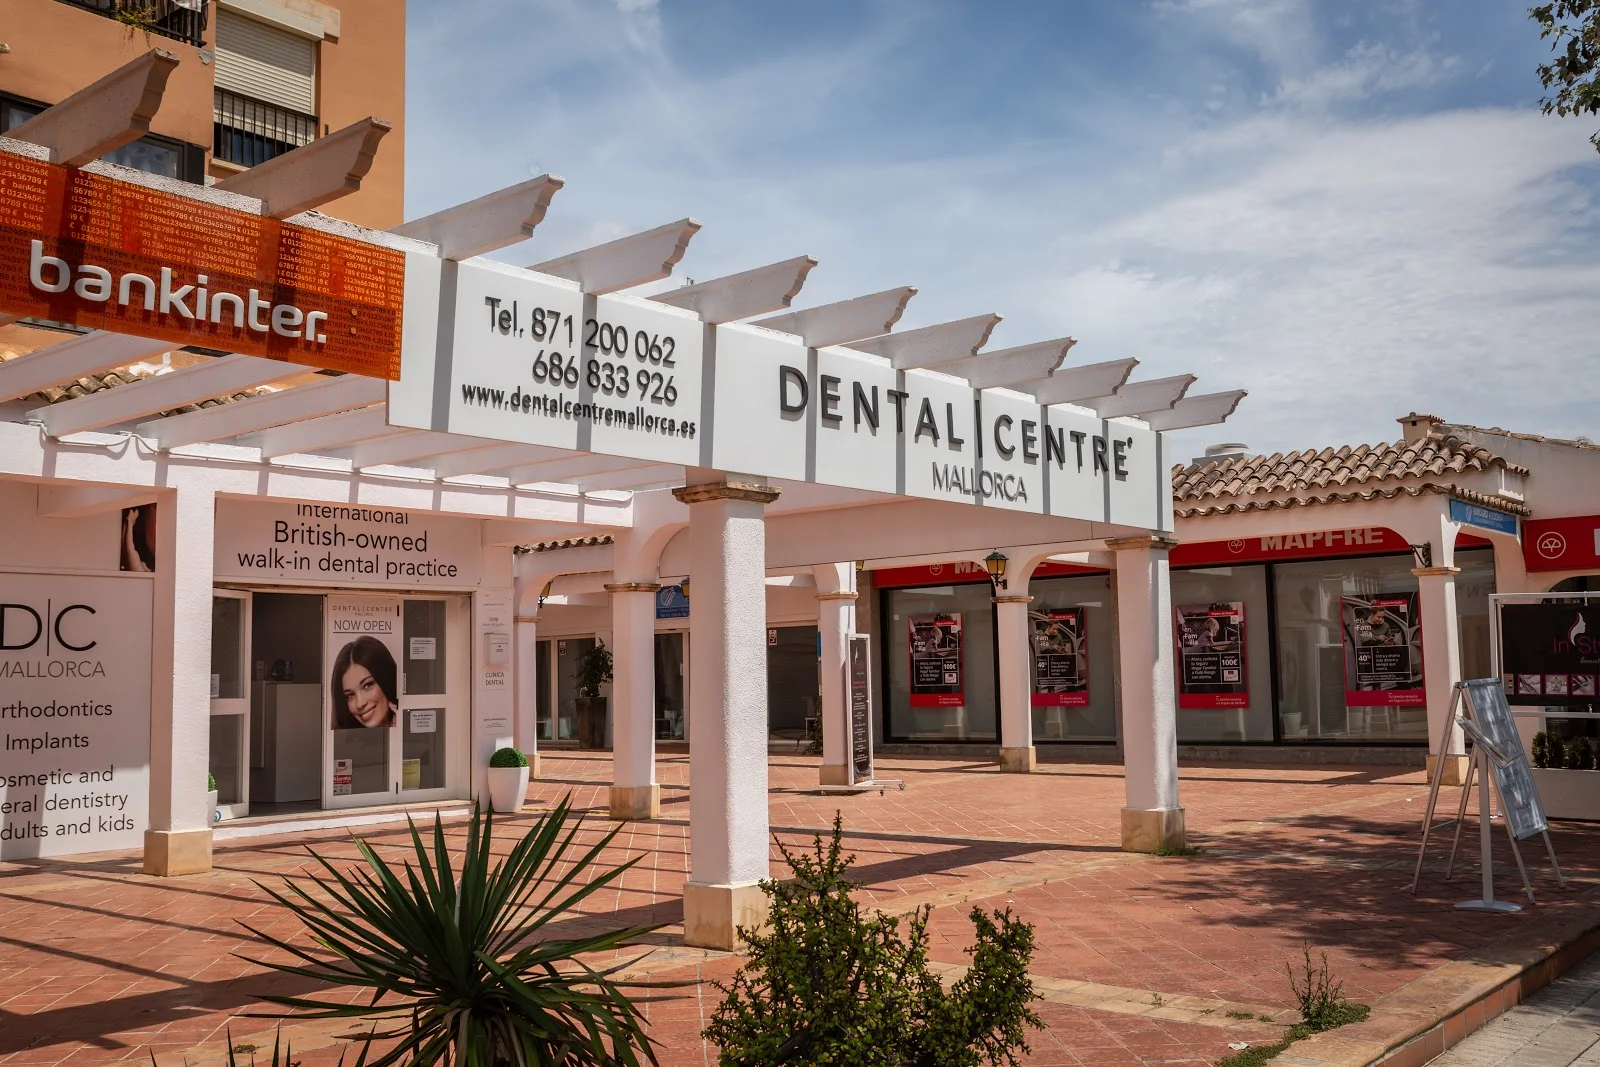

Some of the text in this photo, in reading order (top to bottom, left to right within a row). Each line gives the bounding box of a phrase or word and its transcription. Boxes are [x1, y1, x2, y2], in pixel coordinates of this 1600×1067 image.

[485, 296, 676, 365] Tel. 871 200 062
[533, 350, 678, 404] 686 833 926
[462, 384, 696, 435] www.dentalcentremallorca.es
[932, 462, 1028, 502] MALLORCA
[274, 521, 427, 553] British-owned
[1260, 527, 1384, 552] MAPFRE
[238, 548, 458, 580] walk-in dental practice
[334, 620, 392, 632] NOW OPEN
[6, 732, 90, 754] Implants
[79, 765, 114, 783] and
[1, 791, 129, 814] eral dentistry
[0, 814, 135, 841] dults and kids
